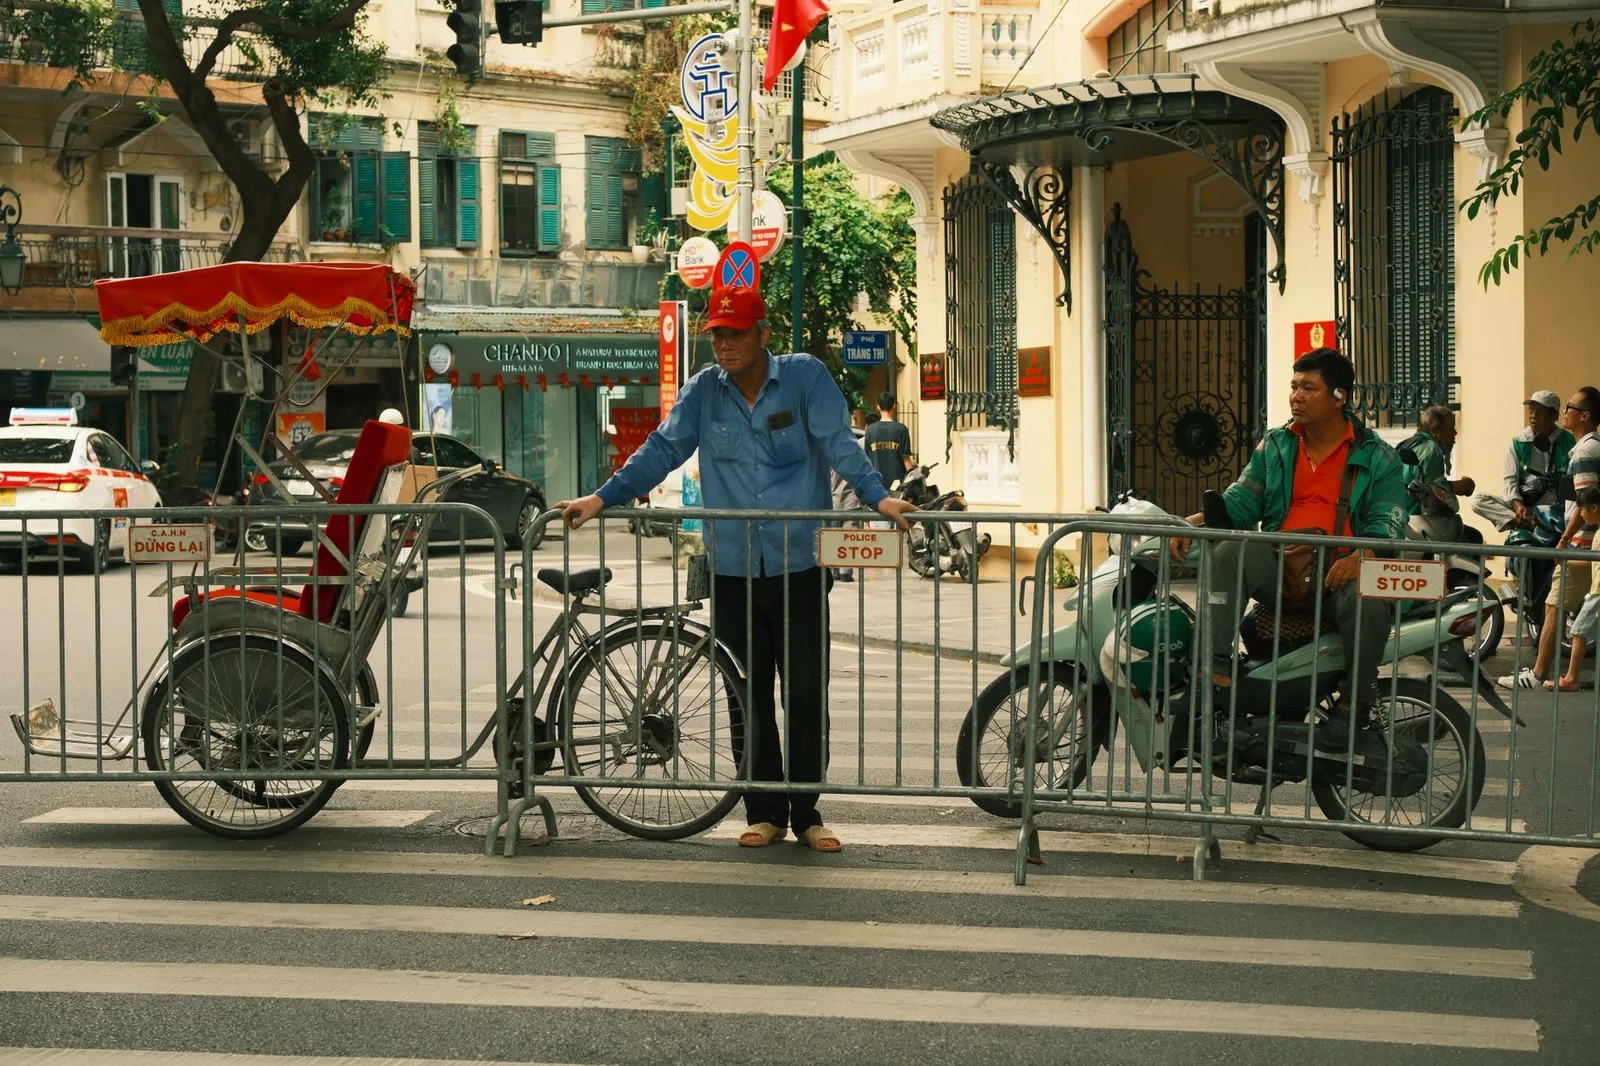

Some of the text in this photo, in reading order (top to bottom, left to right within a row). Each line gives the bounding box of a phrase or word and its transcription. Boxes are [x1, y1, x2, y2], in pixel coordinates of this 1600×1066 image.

[753, 215, 766, 226] nk
[685, 246, 696, 255] HD
[685, 256, 704, 265] Bank
[484, 343, 561, 362] CHANDO
[873, 348, 884, 360] THI
[502, 364, 544, 372] HIMALAYA
[73, 396, 81, 408] 3
[135, 538, 202, 554] DỪNG LẠI
[837, 546, 883, 559] STOP
[1383, 564, 1422, 572] POLICE
[1376, 577, 1427, 591] STOP
[1159, 639, 1183, 652] Gab
